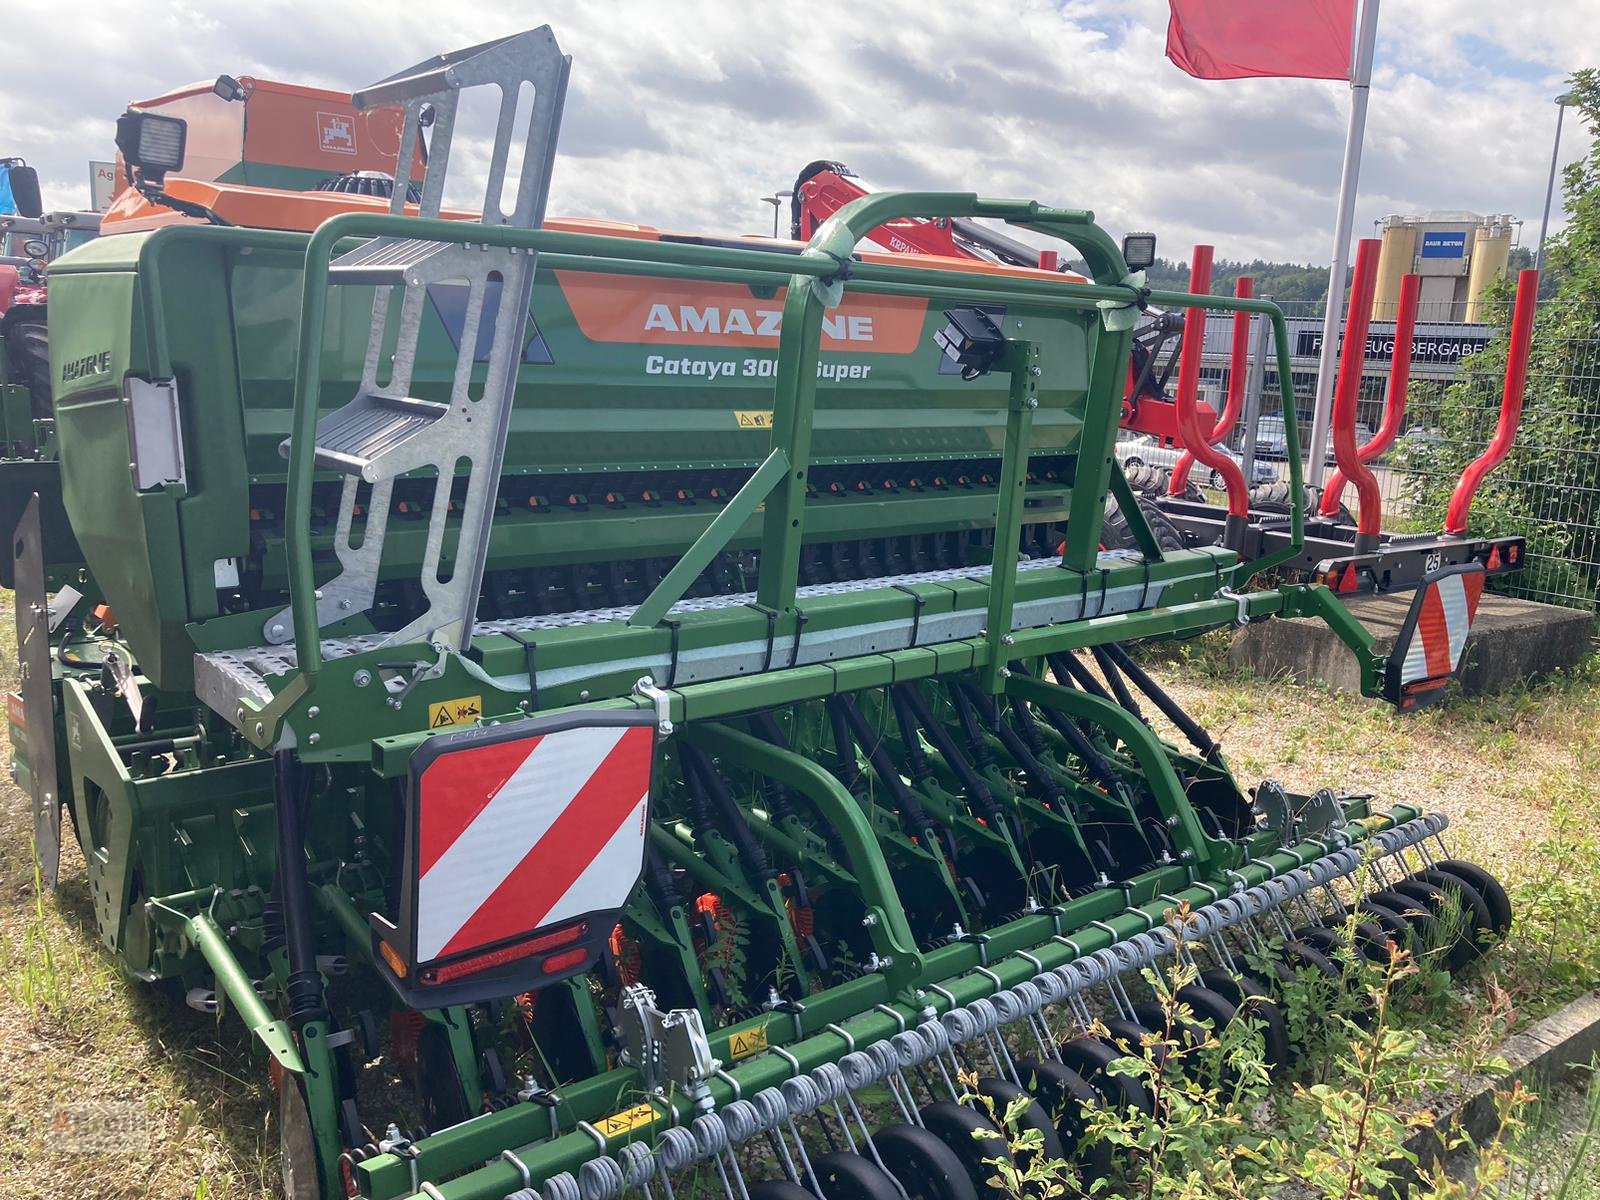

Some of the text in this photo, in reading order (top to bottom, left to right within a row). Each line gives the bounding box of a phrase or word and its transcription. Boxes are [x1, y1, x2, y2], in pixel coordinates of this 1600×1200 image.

[644, 303, 874, 341] AMAZNE
[1312, 338, 1484, 356] FEUGBERGABE
[645, 355, 737, 380] Cataya
[1426, 554, 1440, 571] 25
